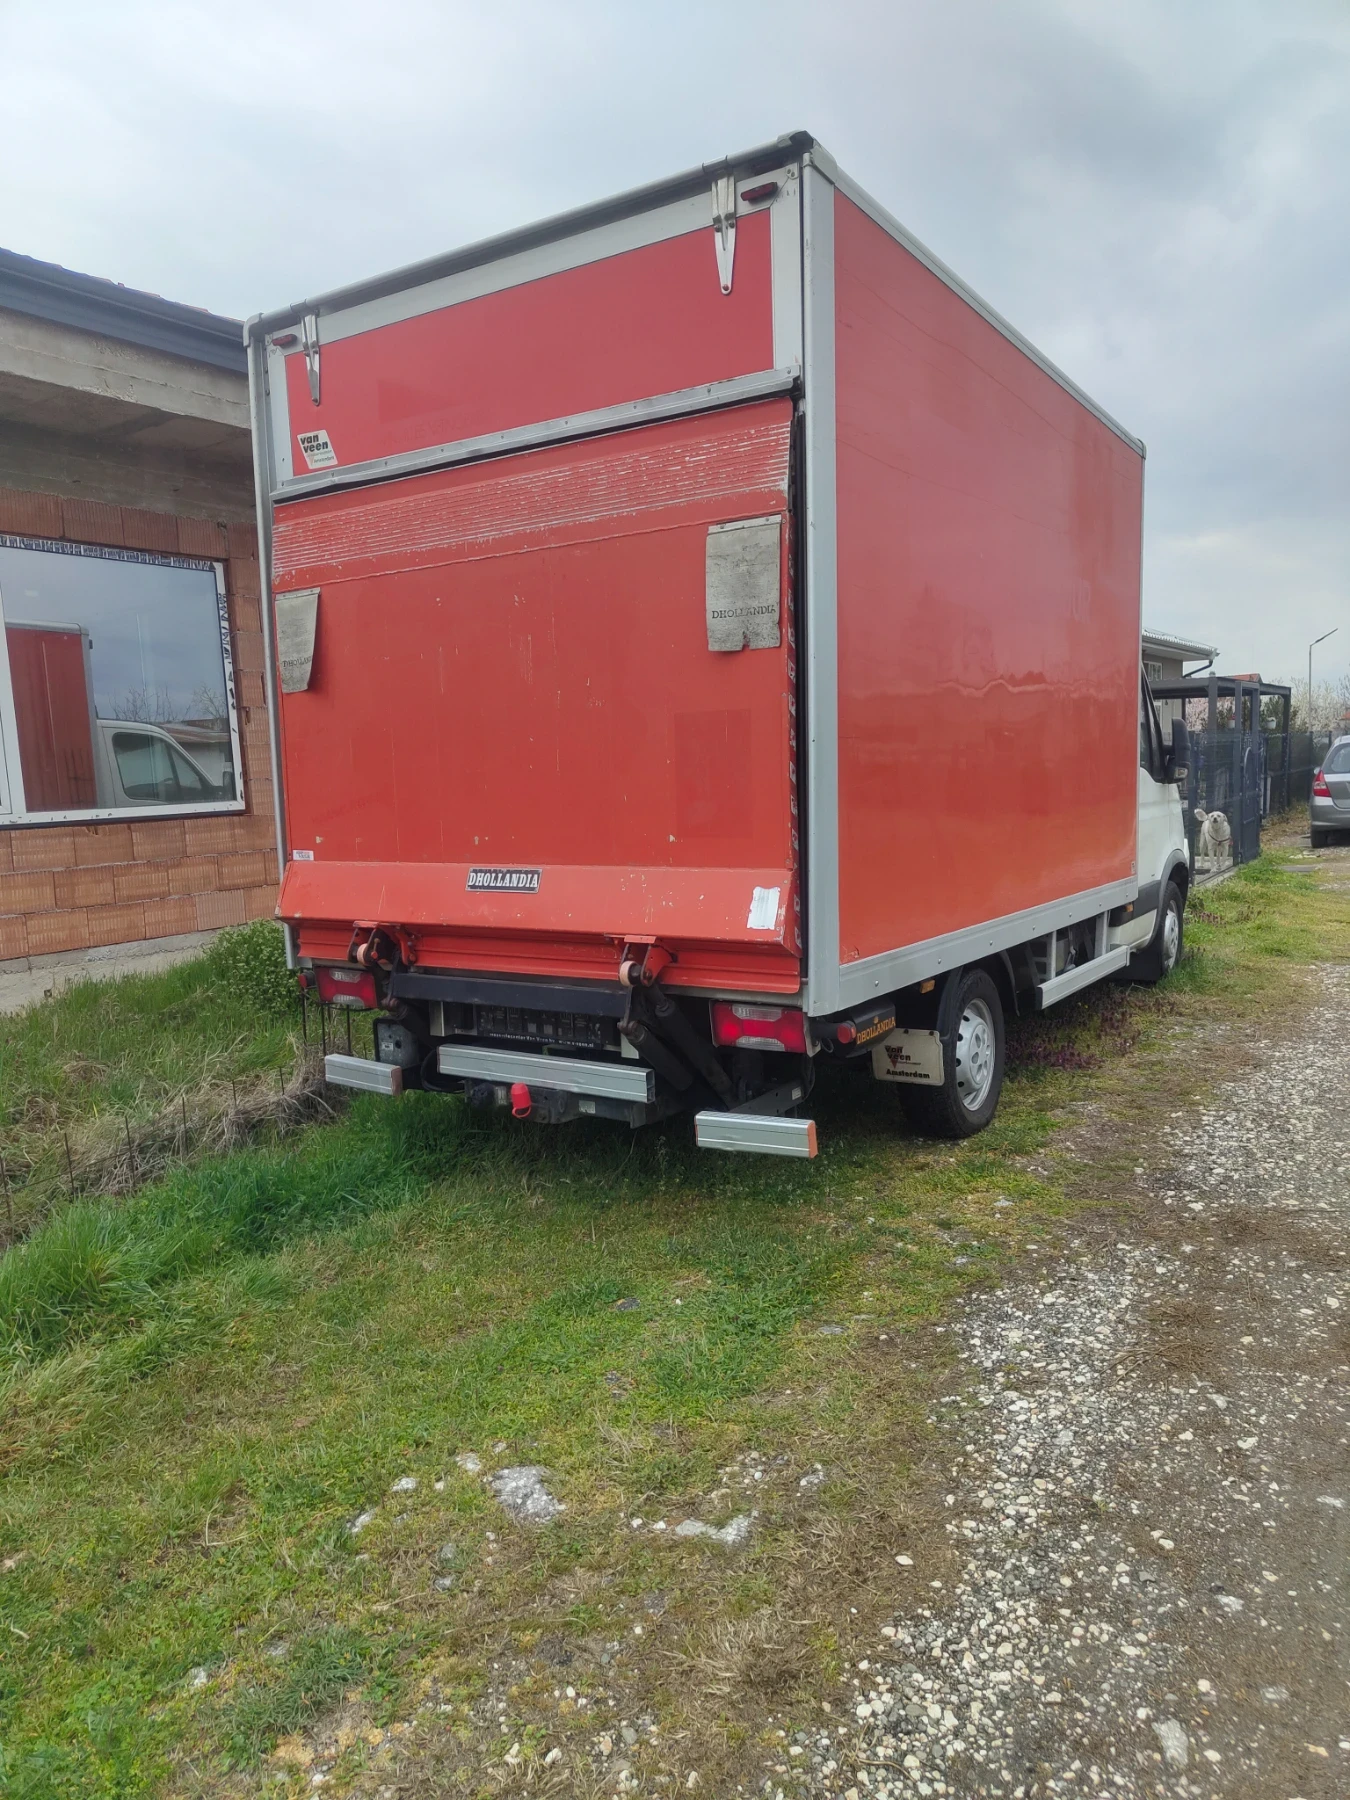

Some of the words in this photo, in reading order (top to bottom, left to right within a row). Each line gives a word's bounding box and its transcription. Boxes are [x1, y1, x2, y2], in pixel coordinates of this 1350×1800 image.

[300, 434, 319, 445] van
[303, 441, 328, 453] veen
[712, 605, 776, 619] DHOLLANDIA
[468, 873, 538, 888] DHOLLANDIA
[856, 1016, 896, 1045] DHOLLANDIA
[886, 1069, 930, 1079] Amsterdam
